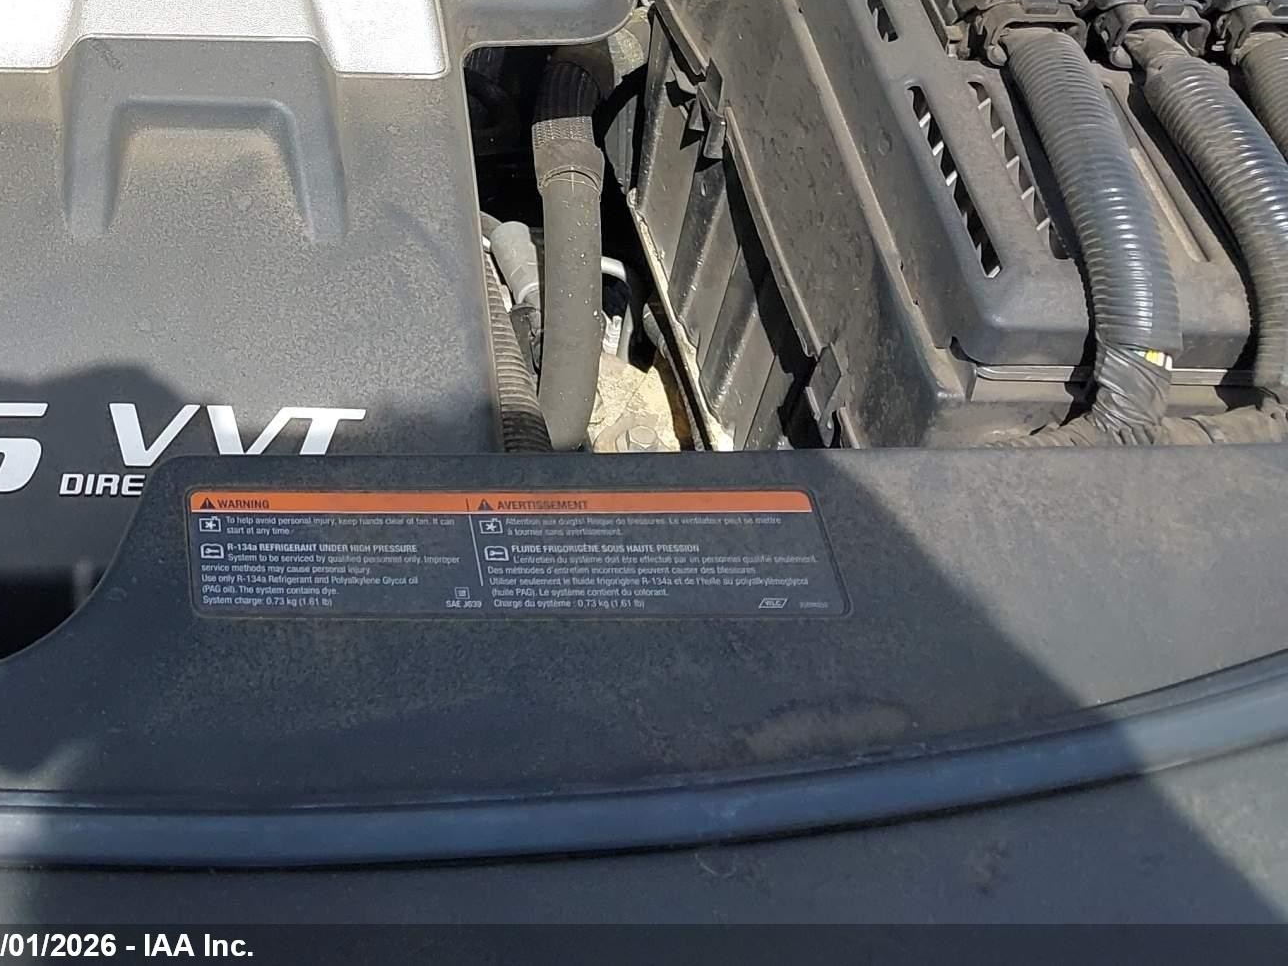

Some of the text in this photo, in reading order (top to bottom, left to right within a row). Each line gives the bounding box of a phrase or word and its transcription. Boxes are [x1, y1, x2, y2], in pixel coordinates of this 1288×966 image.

[109, 403, 367, 467] VVT
[217, 499, 270, 509] WARNING
[497, 500, 588, 510] AVERTISSEMENT
[226, 516, 235, 524] To
[237, 516, 253, 526] help
[255, 516, 277, 525] avoid
[278, 517, 311, 526] personal
[313, 517, 337, 527] injury,
[338, 518, 357, 527] keep
[359, 518, 383, 526] hands
[384, 518, 404, 526] clear
[405, 518, 414, 526] of
[226, 527, 244, 535] start
[246, 527, 254, 535] at
[256, 528, 271, 536] any
[227, 543, 417, 553] R-134a REFRIGERANT UNDER HIGH PRESSURE
[511, 544, 541, 553] FLUIDE
[602, 544, 625, 553] SOUS
[626, 544, 654, 553] HAUTE
[656, 544, 700, 553] PRESSION
[228, 554, 257, 563] System
[259, 554, 268, 562] to
[269, 554, 279, 562] be
[280, 554, 314, 563] serviced
[315, 555, 326, 564] by
[327, 555, 362, 564] qualified
[363, 555, 402, 565] personnel
[424, 555, 460, 565] Improper
[201, 564, 230, 572] service
[231, 564, 266, 573] methods
[268, 565, 285, 574] may
[312, 565, 346, 574] personal
[487, 566, 504, 575] Des
[201, 575, 418, 586] Use only R-134a Refrigerant and Polyalkylene Glycol oil
[489, 577, 517, 586] Utiliser
[519, 577, 562, 586] seulement
[572, 577, 595, 586] fluide
[641, 577, 672, 586] R-134a
[202, 585, 221, 594] (PAG
[239, 585, 254, 594] The
[255, 586, 284, 595] system
[286, 586, 321, 595] contains
[321, 586, 340, 596] dye.
[515, 587, 538, 597] PAG).
[538, 588, 550, 596] Le
[621, 588, 632, 596] du
[203, 595, 232, 605] System
[265, 596, 285, 605] 0.73
[286, 596, 297, 606] kg
[298, 596, 320, 606] (1.61
[322, 596, 333, 606] lb)
[445, 600, 461, 608] SAE
[493, 599, 523, 609] Charge
[524, 599, 536, 608] du
[598, 599, 610, 609] kg
[633, 599, 645, 609] lb)
